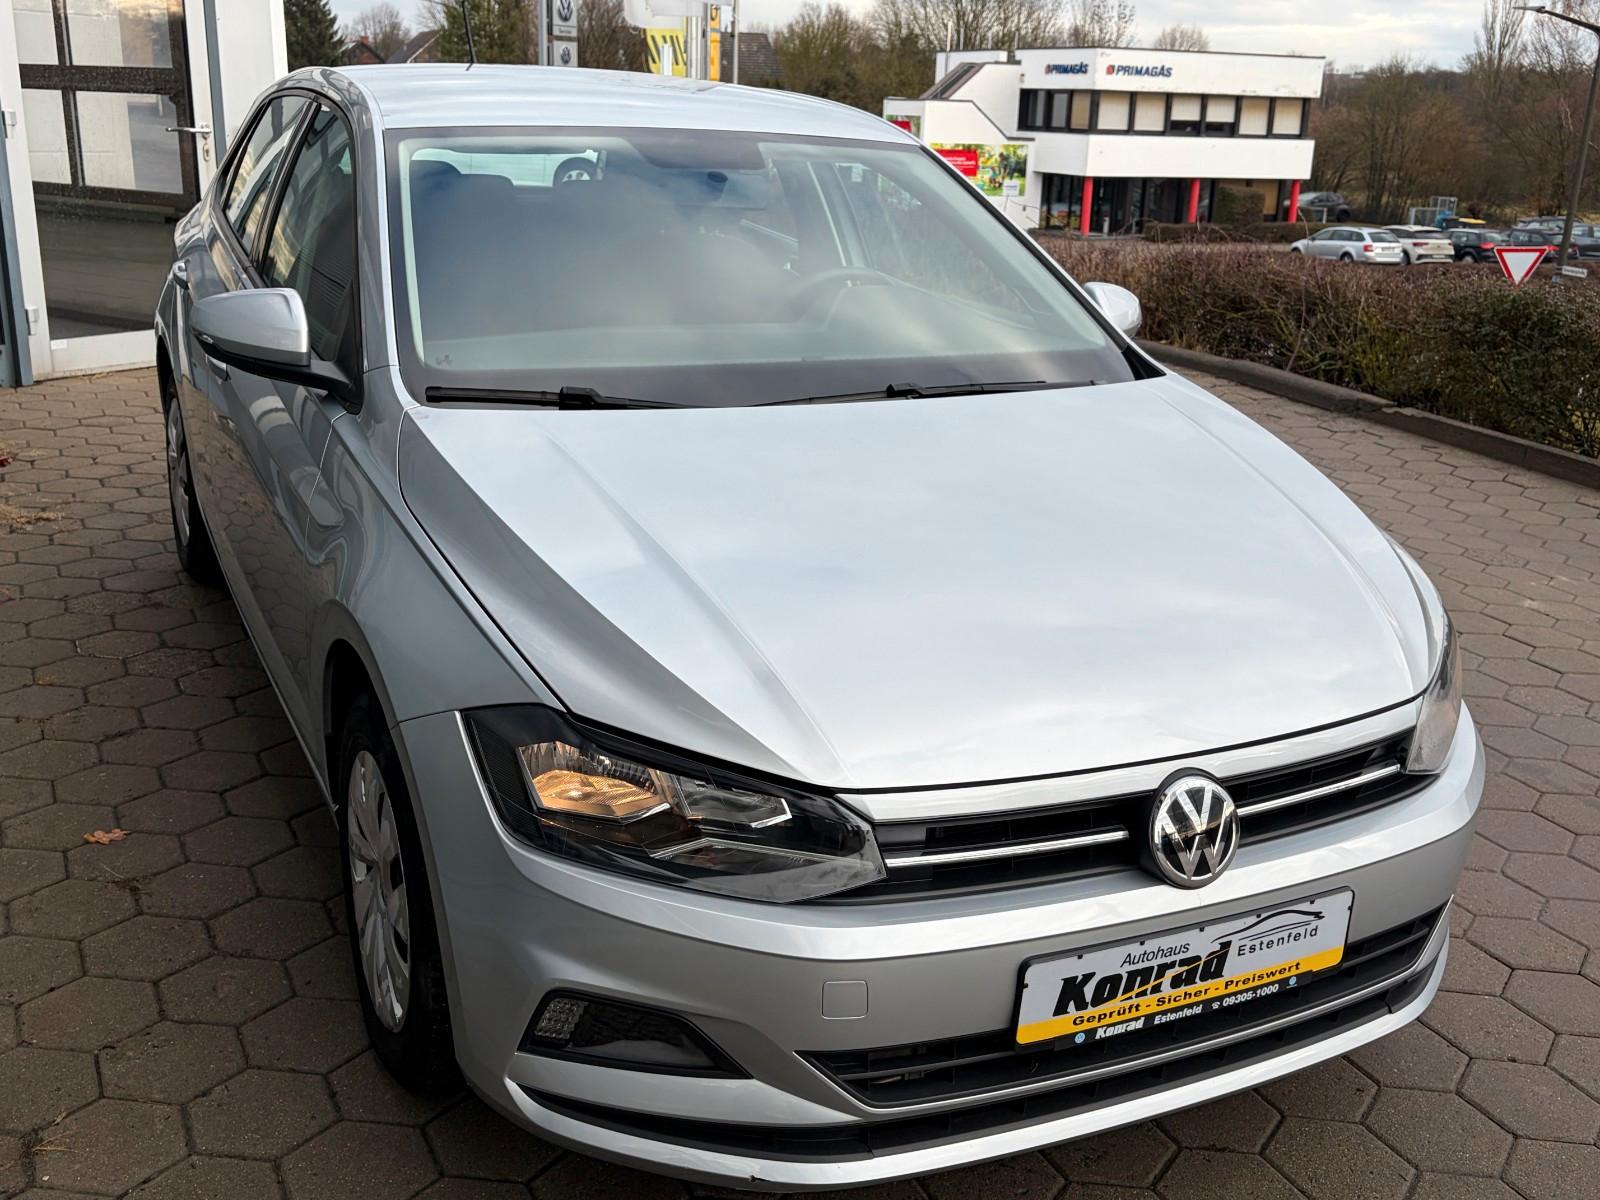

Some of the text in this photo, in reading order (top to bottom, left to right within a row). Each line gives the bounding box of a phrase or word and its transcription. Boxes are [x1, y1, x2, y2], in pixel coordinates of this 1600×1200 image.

[1120, 942, 1190, 968] Autohaus
[1237, 925, 1319, 957] Estenfeld
[1052, 940, 1233, 1017] Konrad
[1072, 1001, 1142, 1027] Geprüft
[1156, 985, 1211, 1008] Sicher
[1224, 961, 1302, 989] Preiswert
[1094, 1017, 1145, 1040] Konrad
[1153, 1004, 1203, 1025] Estenfeld
[1222, 983, 1279, 1007] 09305-1000
